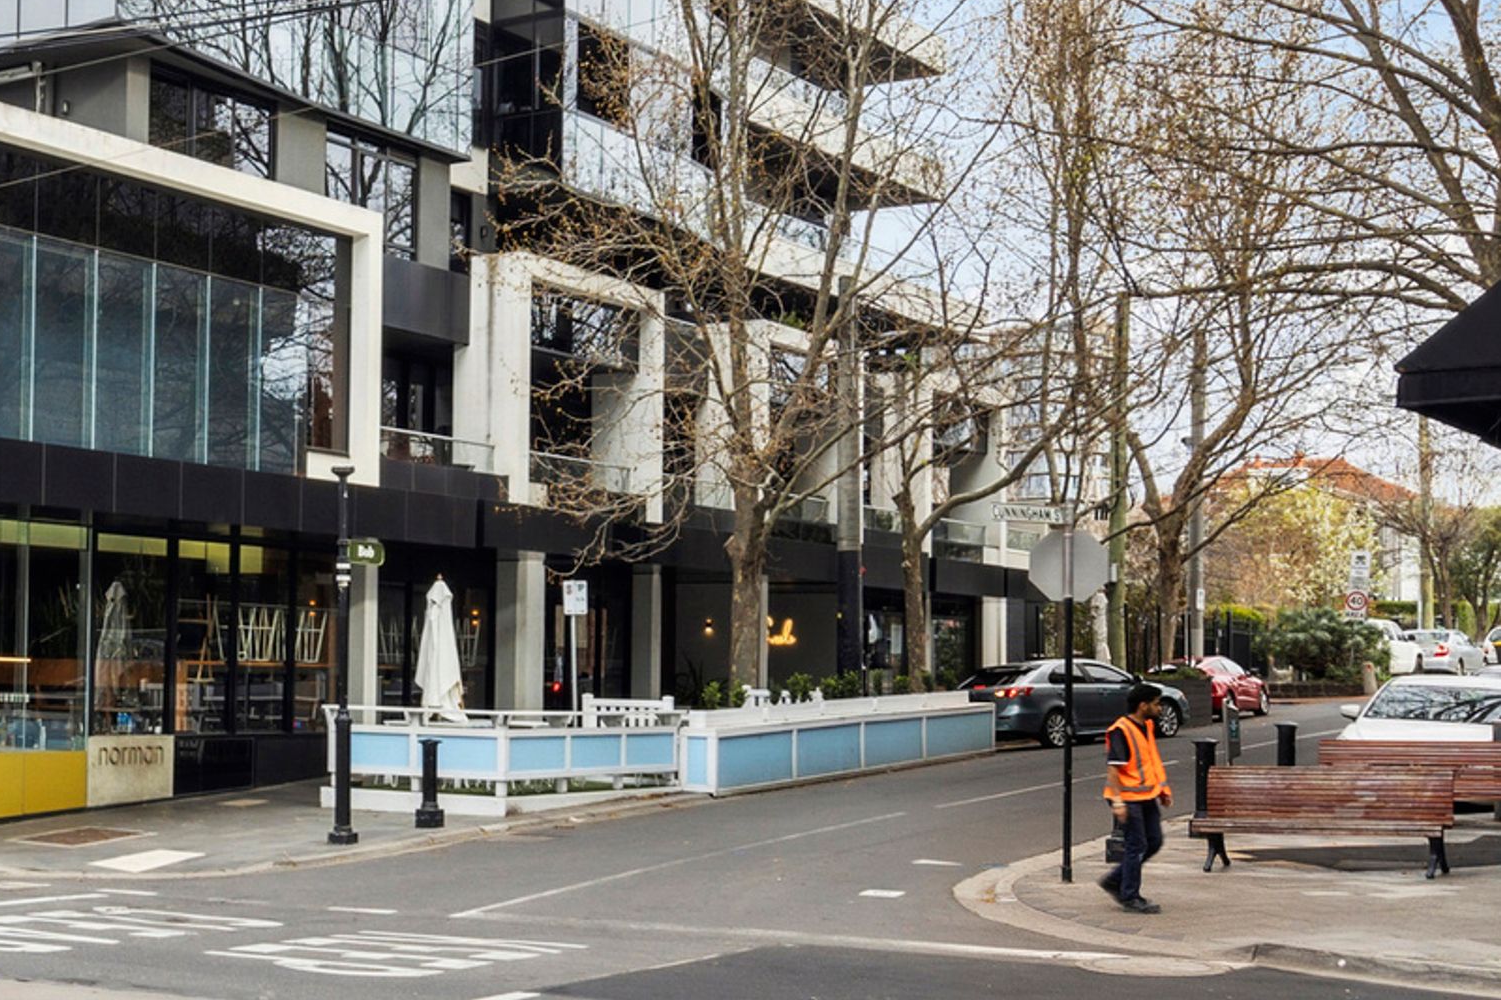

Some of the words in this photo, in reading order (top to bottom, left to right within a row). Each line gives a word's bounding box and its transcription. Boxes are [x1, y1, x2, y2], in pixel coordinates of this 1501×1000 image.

[993, 504, 1051, 521] CUNNINGHAM
[358, 544, 375, 558] Bob
[1351, 596, 1363, 605] 40
[98, 745, 165, 766] norman
